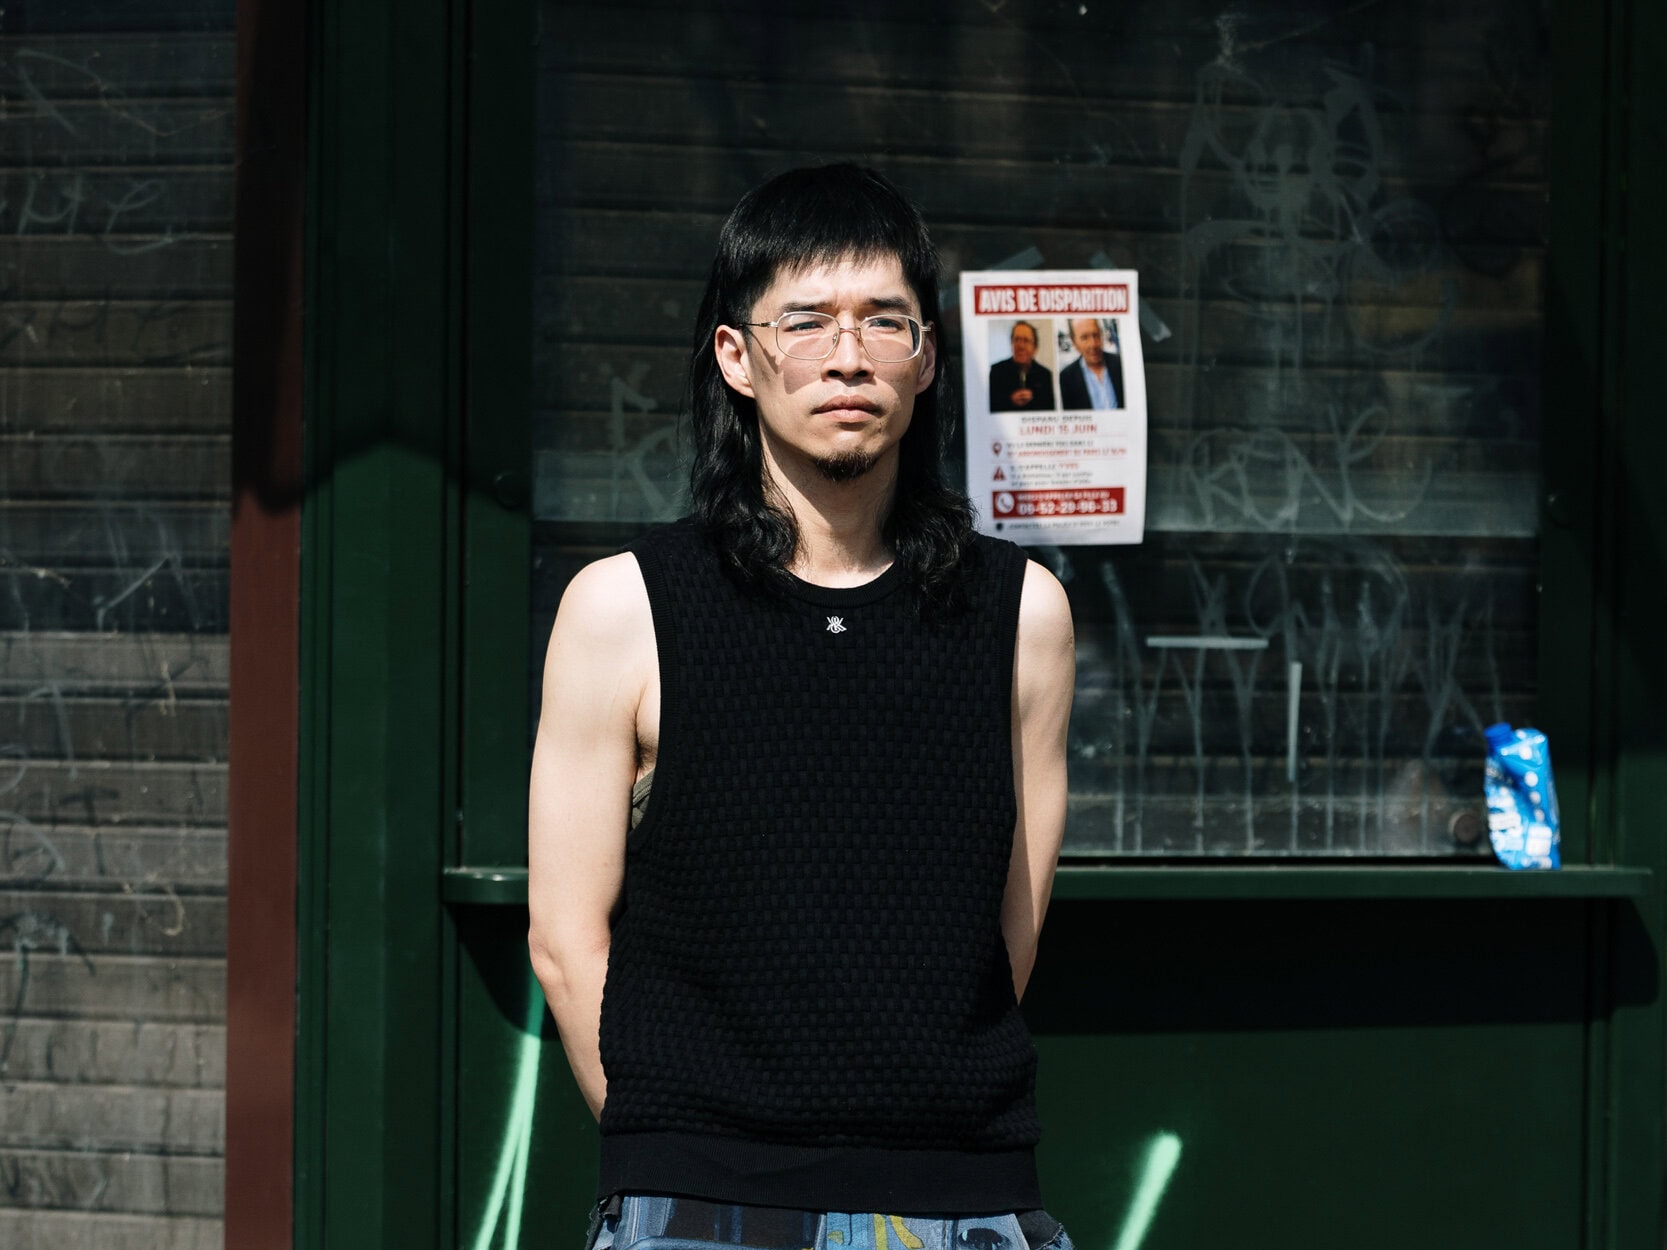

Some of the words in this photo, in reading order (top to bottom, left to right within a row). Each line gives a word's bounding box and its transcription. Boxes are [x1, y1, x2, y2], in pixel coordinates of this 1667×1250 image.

[979, 287, 1016, 313] AVIS
[1017, 287, 1038, 312] DE
[1038, 286, 1127, 312] DISPARITION
[1073, 423, 1097, 434] JUIN
